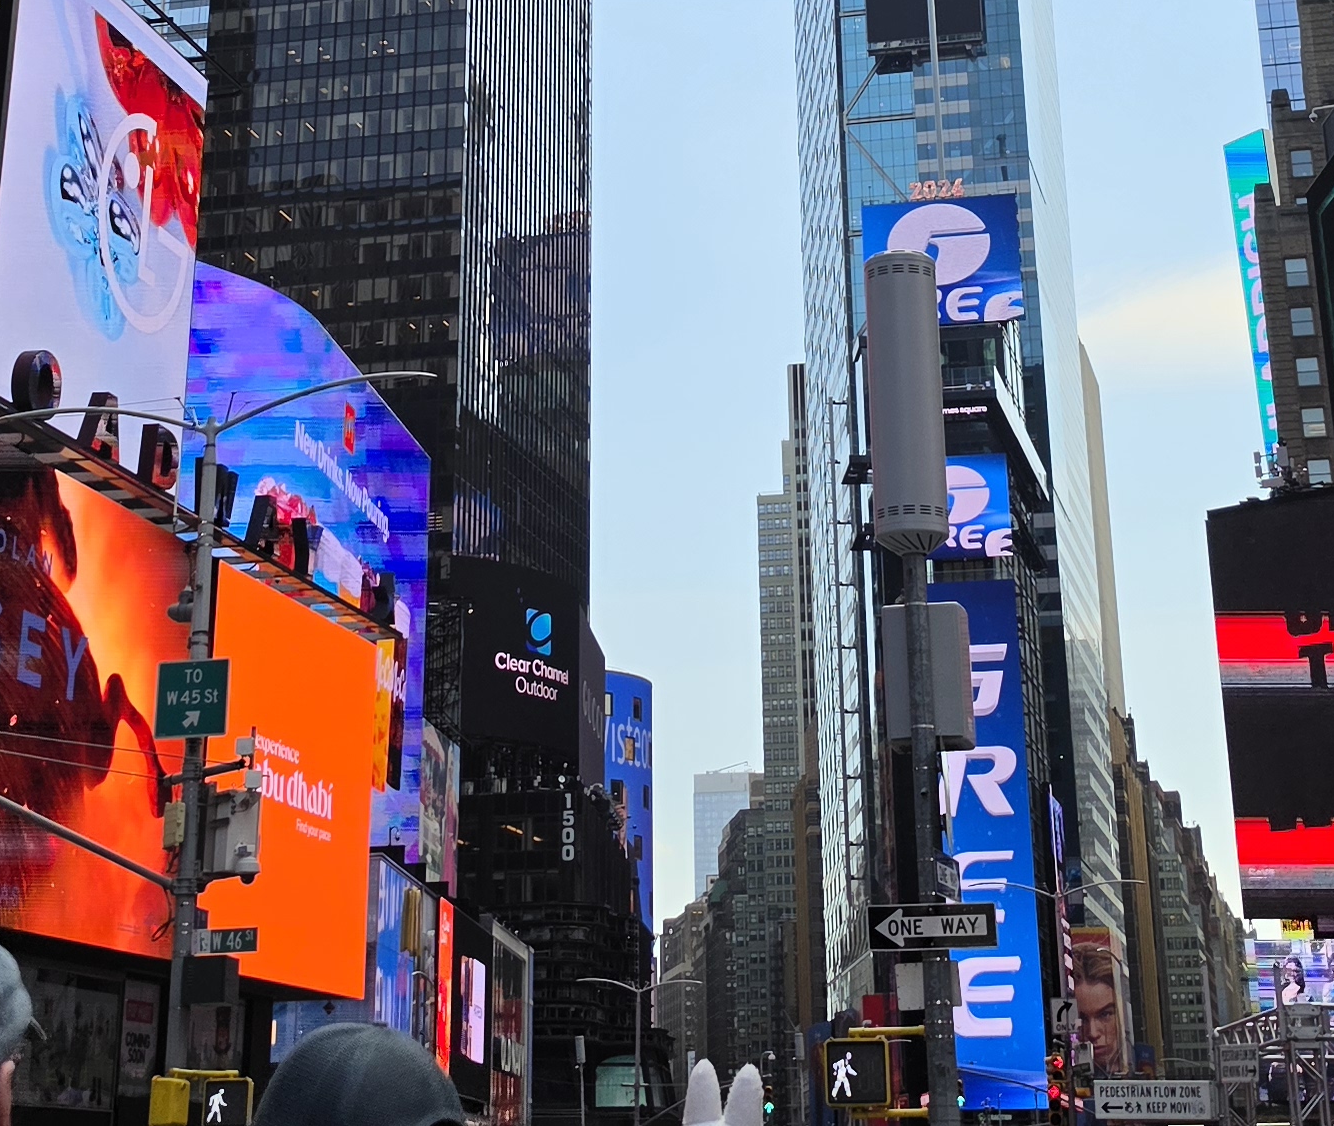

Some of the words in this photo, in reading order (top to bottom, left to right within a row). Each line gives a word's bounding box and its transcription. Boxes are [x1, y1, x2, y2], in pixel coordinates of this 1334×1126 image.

[294, 420, 317, 466] New
[345, 468, 363, 506] Now
[184, 668, 203, 684] TO
[494, 652, 531, 673] Clear
[532, 659, 569, 686] Channel
[167, 690, 179, 706] W
[180, 690, 201, 705] 45
[204, 688, 219, 704] St
[515, 676, 559, 702] Outdoor
[256, 733, 300, 765] experience
[286, 771, 333, 820] dhabi
[560, 793, 576, 862] 1500
[888, 919, 924, 937] ONE
[940, 917, 979, 935] WAY
[212, 932, 223, 950] W
[226, 932, 242, 950] 46
[1055, 1023, 1076, 1033] ONLY
[125, 1031, 151, 1050] COMING
[127, 1047, 146, 1064] SOON
[1099, 1085, 1152, 1099] PEDESTRIAN
[1154, 1086, 1176, 1099] FLOW
[1179, 1085, 1202, 1099] ZONE
[1146, 1101, 1167, 1114] KEEP
[1170, 1101, 1206, 1116] MOVI
